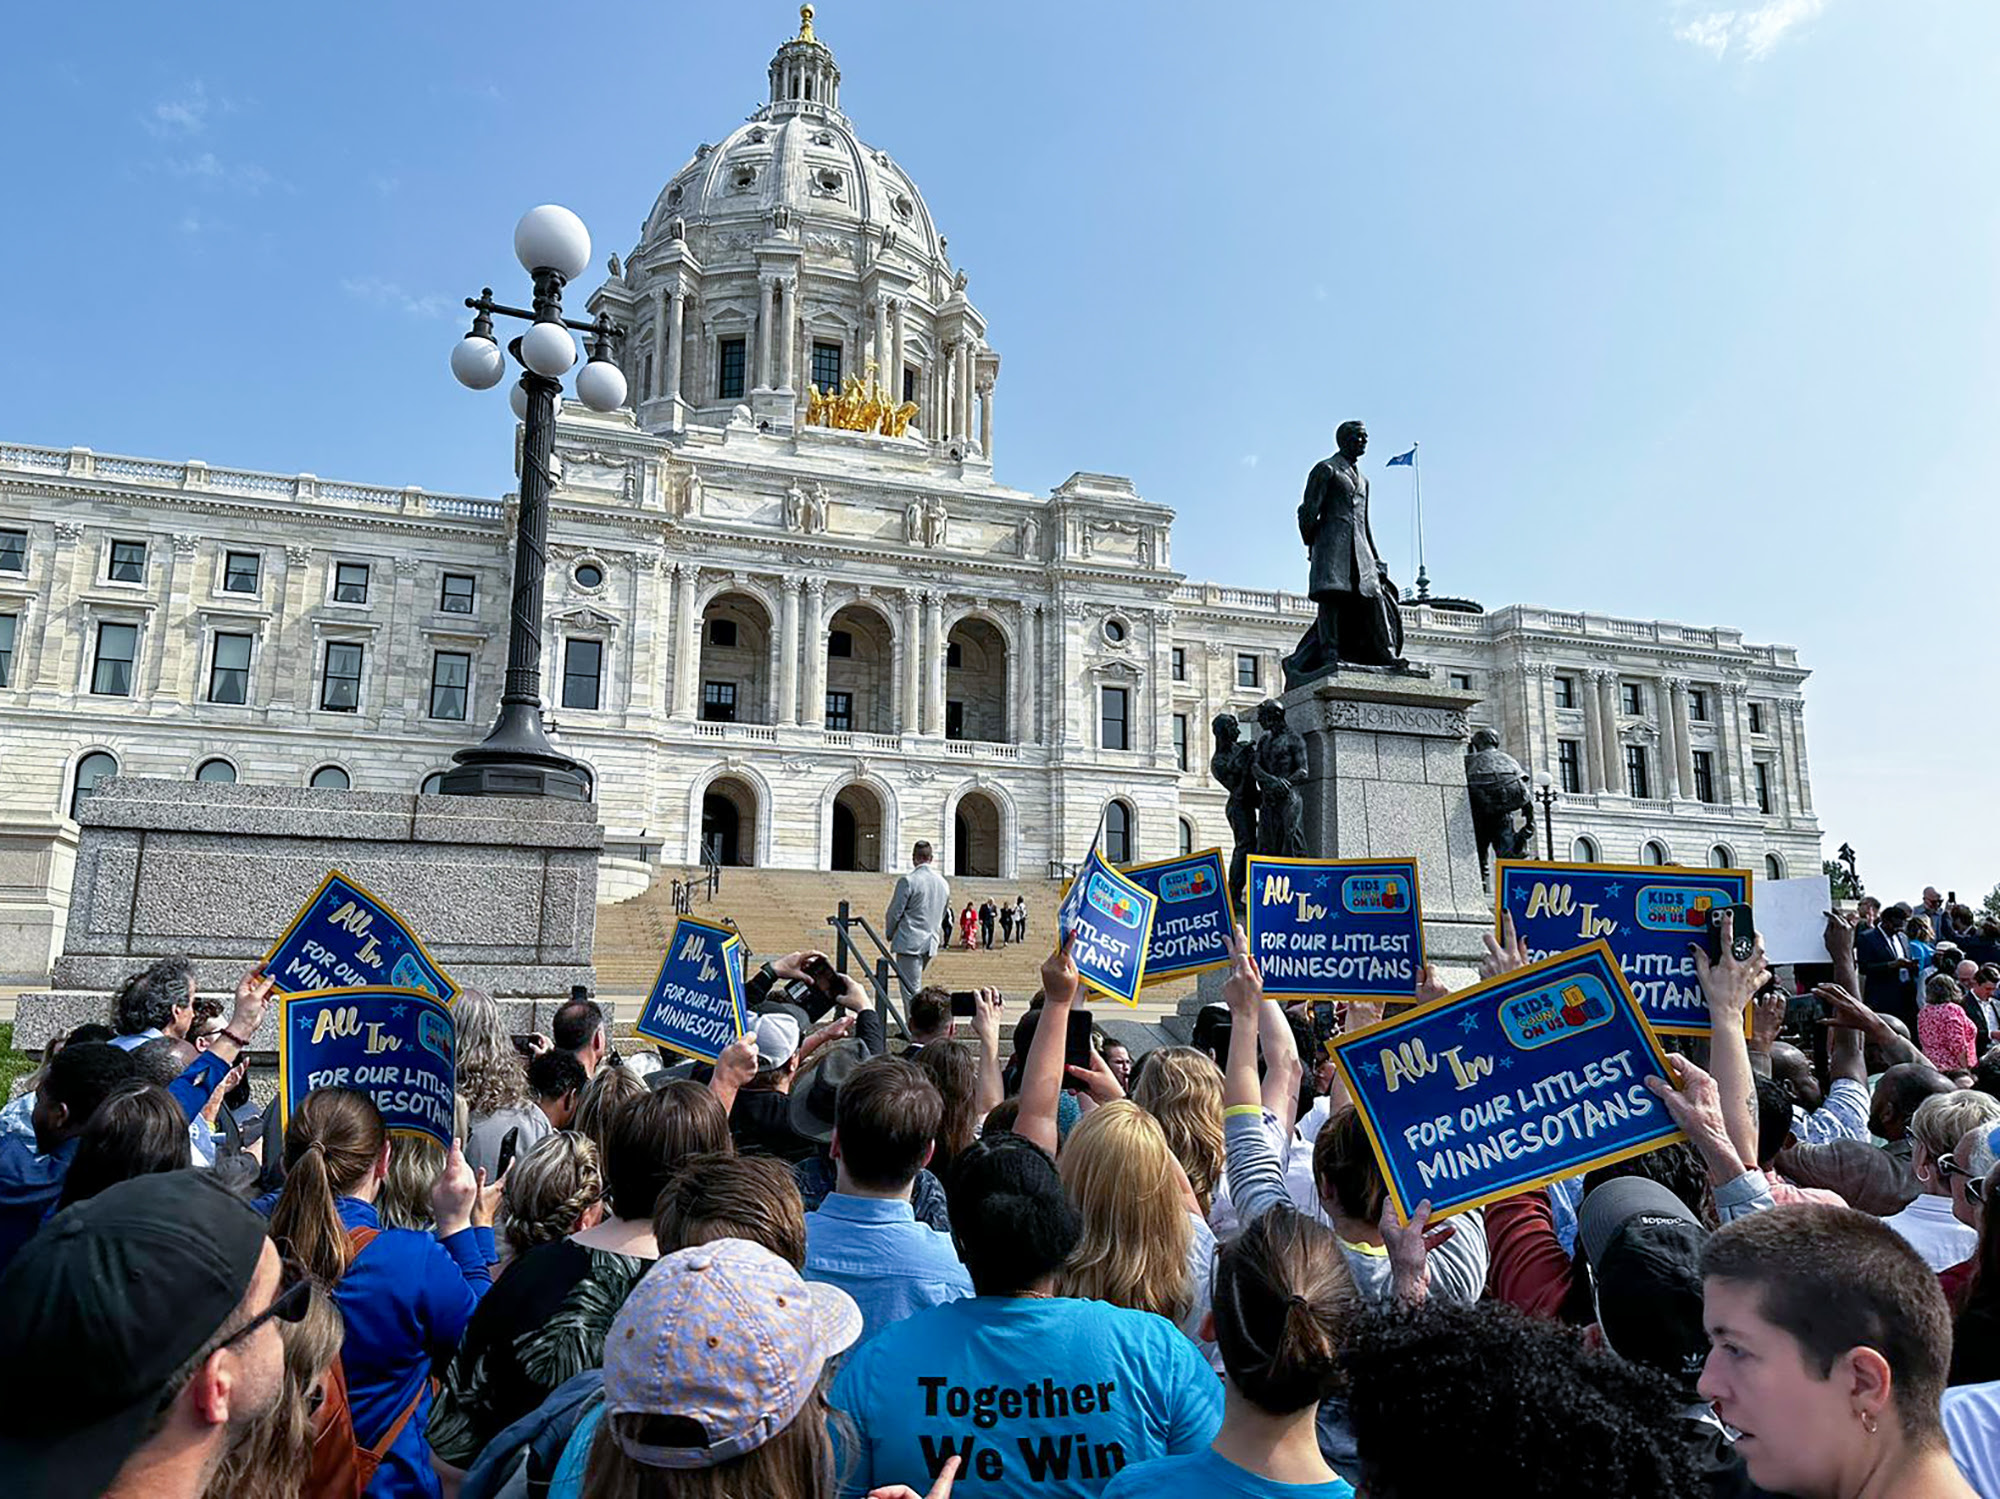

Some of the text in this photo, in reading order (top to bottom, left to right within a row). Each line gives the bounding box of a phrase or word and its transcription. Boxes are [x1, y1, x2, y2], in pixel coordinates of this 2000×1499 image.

[1363, 708, 1442, 728] JOHNSON
[1262, 874, 1328, 922] All In
[1352, 880, 1380, 890] KIDS
[1648, 891, 1685, 904] KIDS
[1157, 910, 1219, 937] LITTLEST
[1525, 882, 1618, 939] All In
[1648, 912, 1685, 923] ON US
[328, 901, 384, 969] All In
[1074, 916, 1130, 958] ITTLEST
[1260, 932, 1410, 953] FOR OUR LITTLEST
[301, 939, 337, 968] FOR
[334, 962, 368, 987] OUR
[678, 933, 719, 982] All In
[1074, 939, 1124, 979] TANS
[1260, 955, 1412, 981] MINNESOTANS
[1620, 953, 1697, 976] LITTLE
[663, 983, 735, 1019] FOR OUR LITTL
[1510, 993, 1553, 1019] KIDS
[311, 1006, 363, 1044] All
[364, 1022, 403, 1054] In
[653, 1003, 735, 1046] MINNESOTAN
[1522, 1016, 1565, 1039] ON US
[308, 1068, 350, 1091] FOR
[354, 1066, 400, 1085] OUR
[1378, 1037, 1494, 1093] All In
[1403, 1049, 1634, 1151] FOR OUR LITTLEST
[1415, 1083, 1653, 1189] MINNESOTANS
[917, 1376, 1115, 1428] Together
[918, 1433, 1126, 1483] We Win
